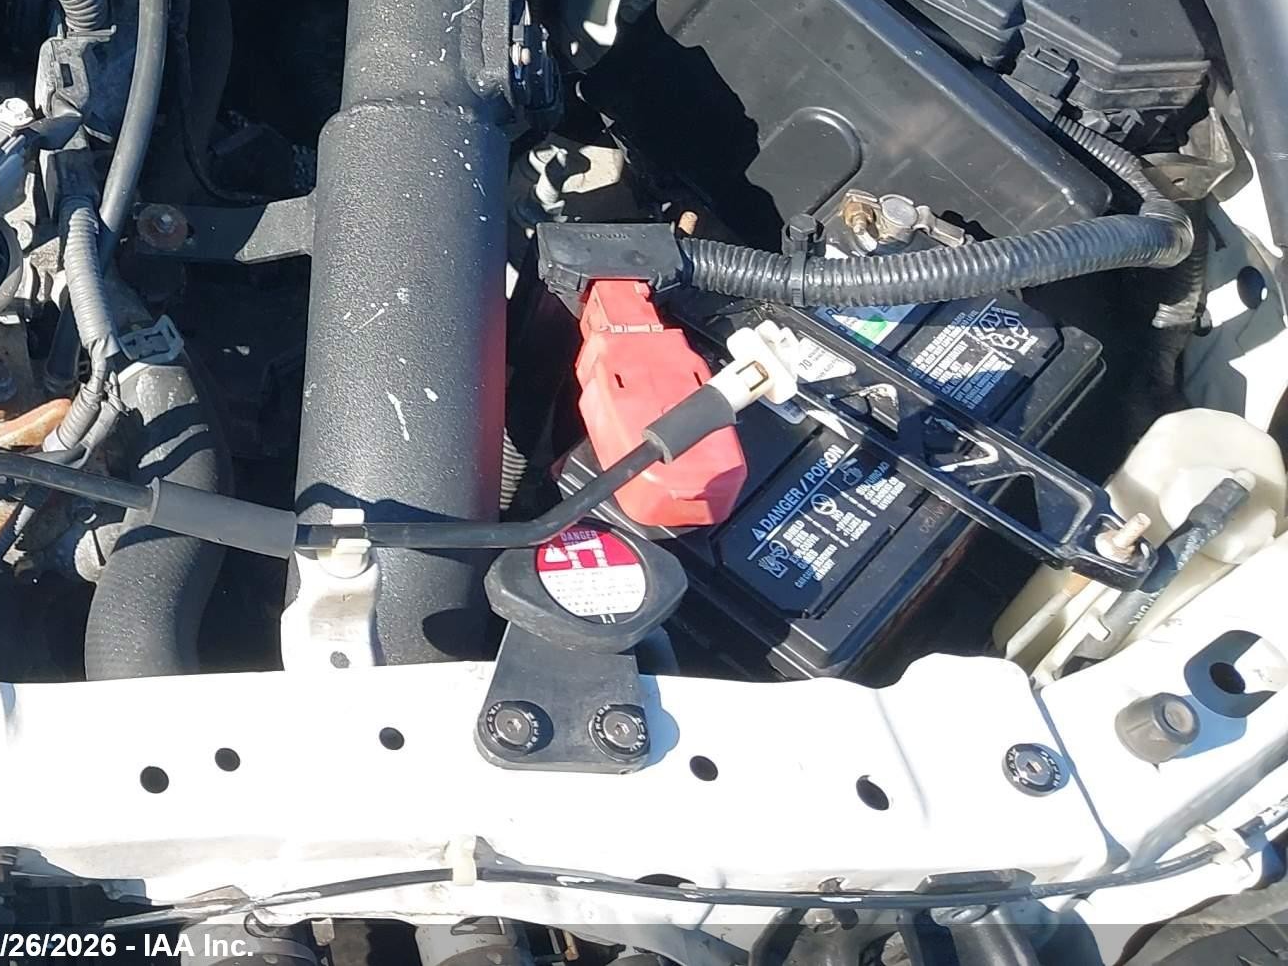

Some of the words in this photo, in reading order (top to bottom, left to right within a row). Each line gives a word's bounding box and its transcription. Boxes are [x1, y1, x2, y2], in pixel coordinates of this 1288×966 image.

[759, 489, 805, 530] DANGER
[803, 444, 844, 483] POISON
[560, 530, 599, 542] DANGER
